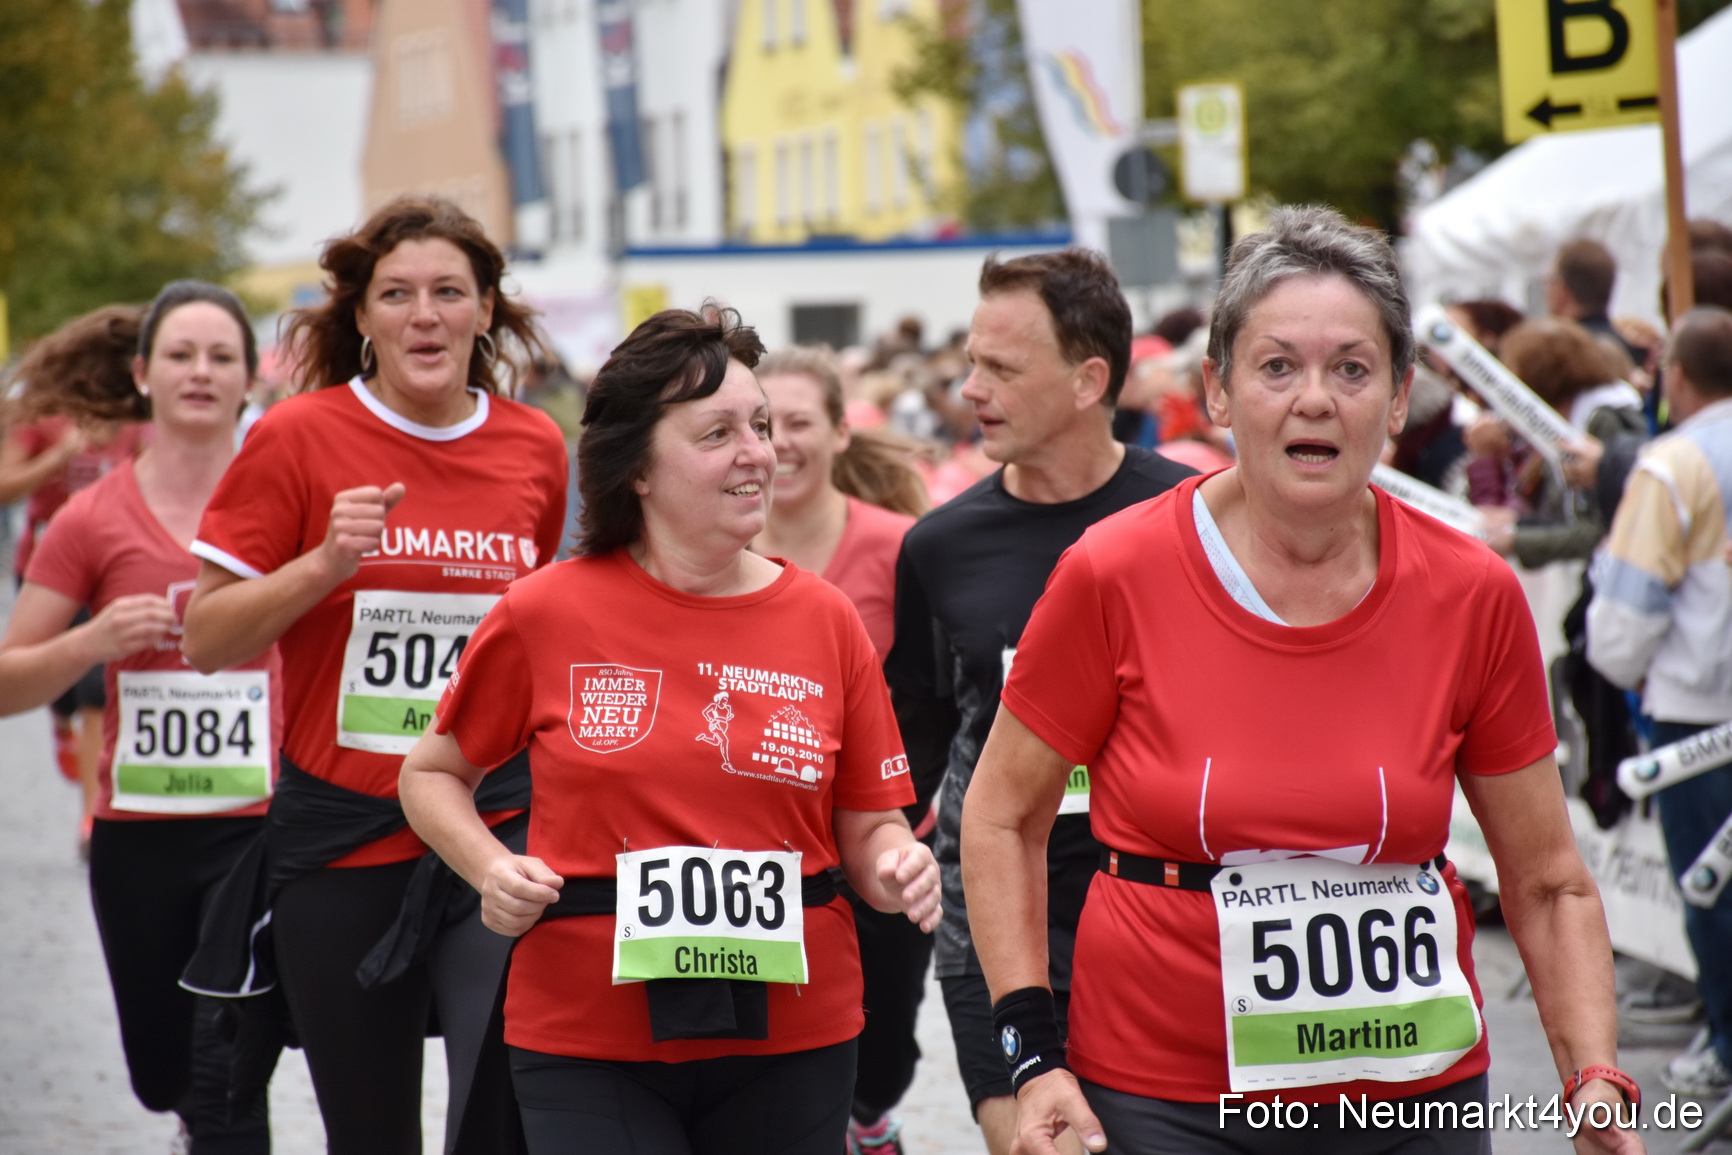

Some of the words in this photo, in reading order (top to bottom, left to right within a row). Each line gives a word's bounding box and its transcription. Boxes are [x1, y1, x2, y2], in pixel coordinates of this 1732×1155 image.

[1546, 0, 1630, 76] B
[442, 567, 482, 579] STARKE
[485, 569, 517, 581] STADT
[360, 608, 416, 624] PARTL
[584, 677, 646, 692] IMMER
[697, 662, 718, 677] 11.
[722, 665, 824, 698] NEUMARKTER
[718, 678, 806, 702] STADTLAUF
[123, 686, 164, 700] PARTL
[169, 686, 241, 701] Neumarkt
[580, 692, 647, 707] WIEDER
[580, 706, 642, 725] NEU
[134, 709, 254, 758] 5084
[578, 726, 639, 738] MARKT
[760, 741, 824, 764] 19.09.2010
[164, 773, 214, 794] Julia
[638, 857, 785, 930] 5063
[1222, 883, 1306, 908] PARTL
[1312, 876, 1413, 899] Neumarkt
[624, 926, 631, 938] S
[675, 946, 758, 975] Christa
[1253, 906, 1441, 1002] 5066
[1238, 999, 1247, 1013] S
[1297, 1019, 1418, 1054] Martina
